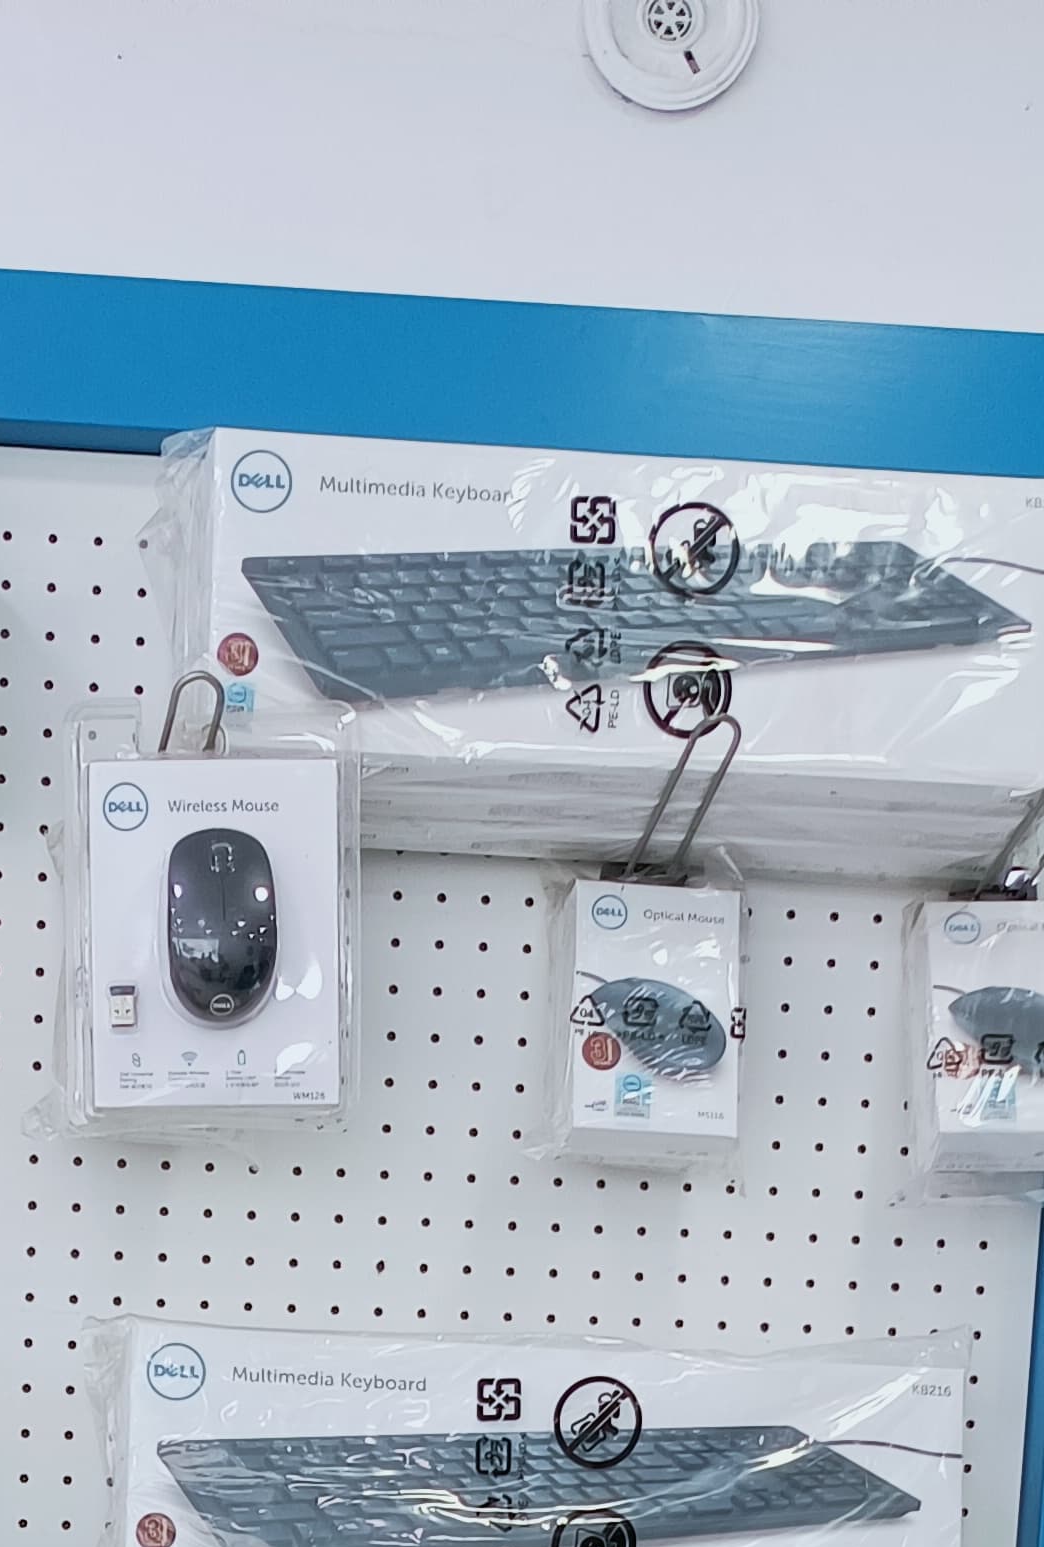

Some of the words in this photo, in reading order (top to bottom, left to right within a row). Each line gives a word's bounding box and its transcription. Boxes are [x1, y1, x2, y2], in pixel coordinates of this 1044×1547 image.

[237, 473, 286, 490] DELL
[319, 475, 426, 498] Multimedia
[432, 482, 512, 504] Keyboar
[108, 801, 144, 813] DELL
[167, 799, 228, 813] Wireless
[232, 799, 279, 813] Mouse
[596, 907, 624, 918] DELL
[643, 908, 684, 922] Optical
[687, 913, 725, 925] Mouse
[153, 1363, 200, 1379] DELL
[231, 1366, 334, 1387] Multimedia
[340, 1372, 427, 1393] Keyboard
